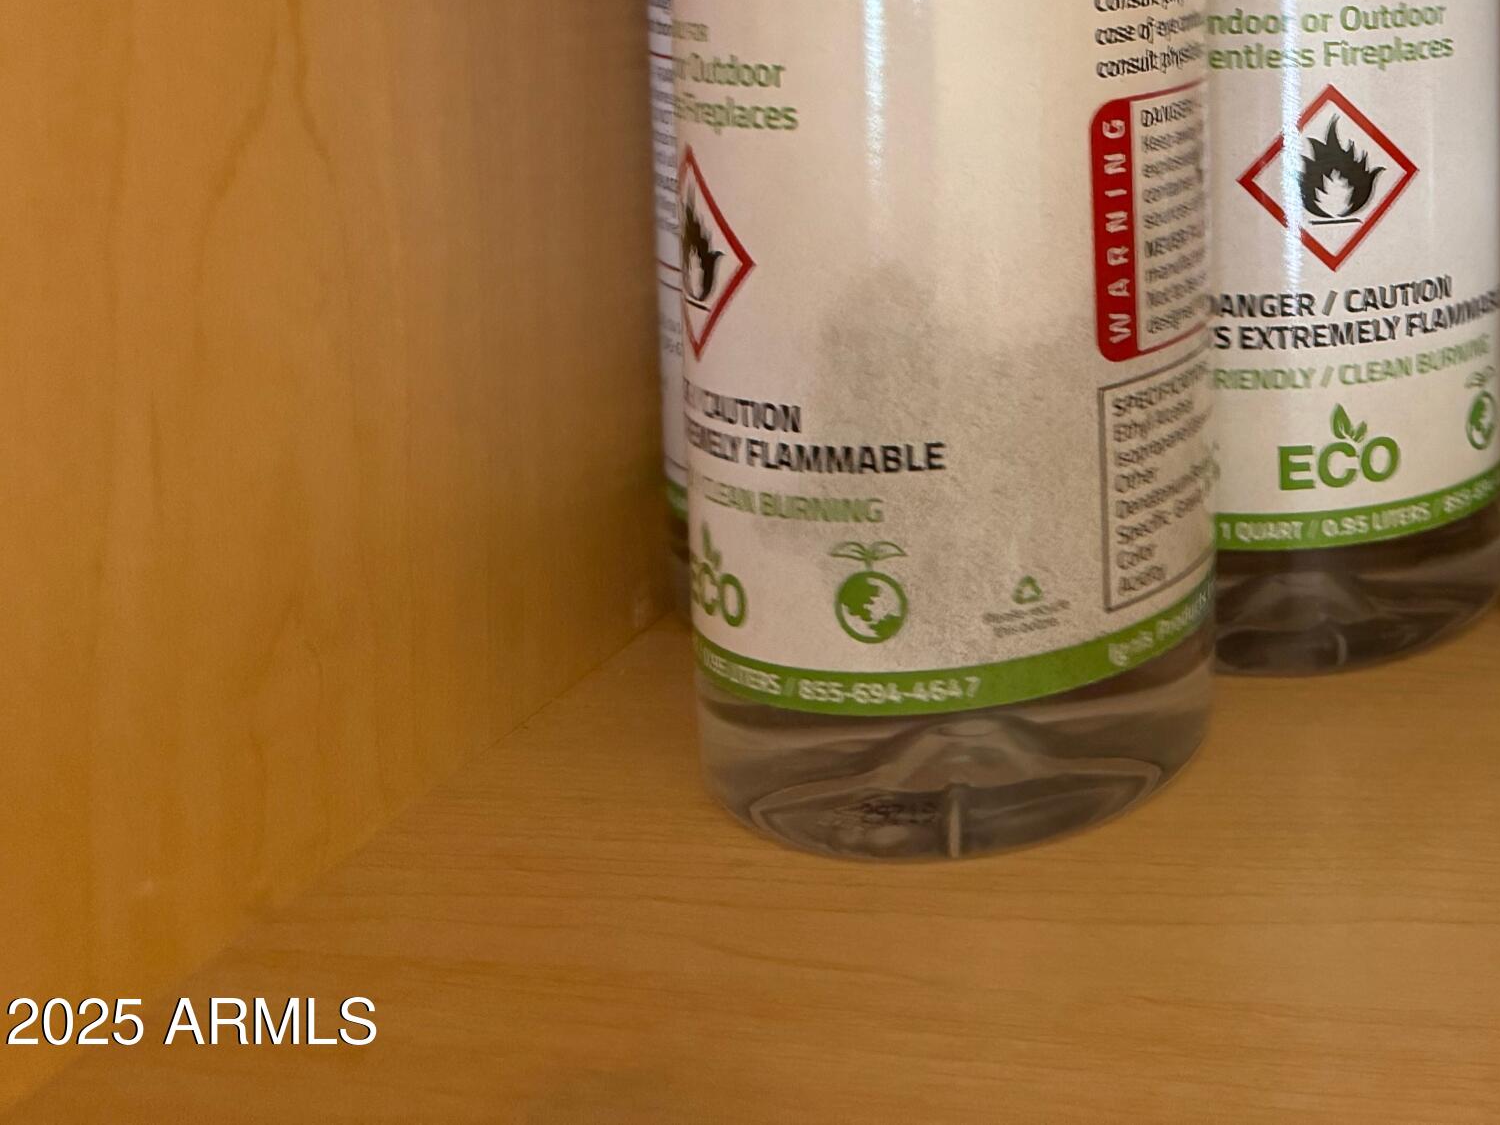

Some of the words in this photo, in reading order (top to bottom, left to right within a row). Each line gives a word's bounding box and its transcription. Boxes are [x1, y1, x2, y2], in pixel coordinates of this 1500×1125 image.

[1301, 12, 1333, 34] or
[1340, 2, 1447, 32] Outdoor
[1323, 36, 1454, 72] Fireplaces
[1101, 119, 1133, 345] WARNING
[1344, 274, 1453, 313] CAUTION
[1238, 315, 1401, 350] EXTREMELY
[1338, 357, 1412, 386] CLEAN
[744, 436, 947, 475] FLAMMABLE
[1278, 436, 1399, 491] ECO
[757, 491, 886, 525] BURNING
[1234, 520, 1304, 542] QUART
[1371, 502, 1431, 531] LITERS
